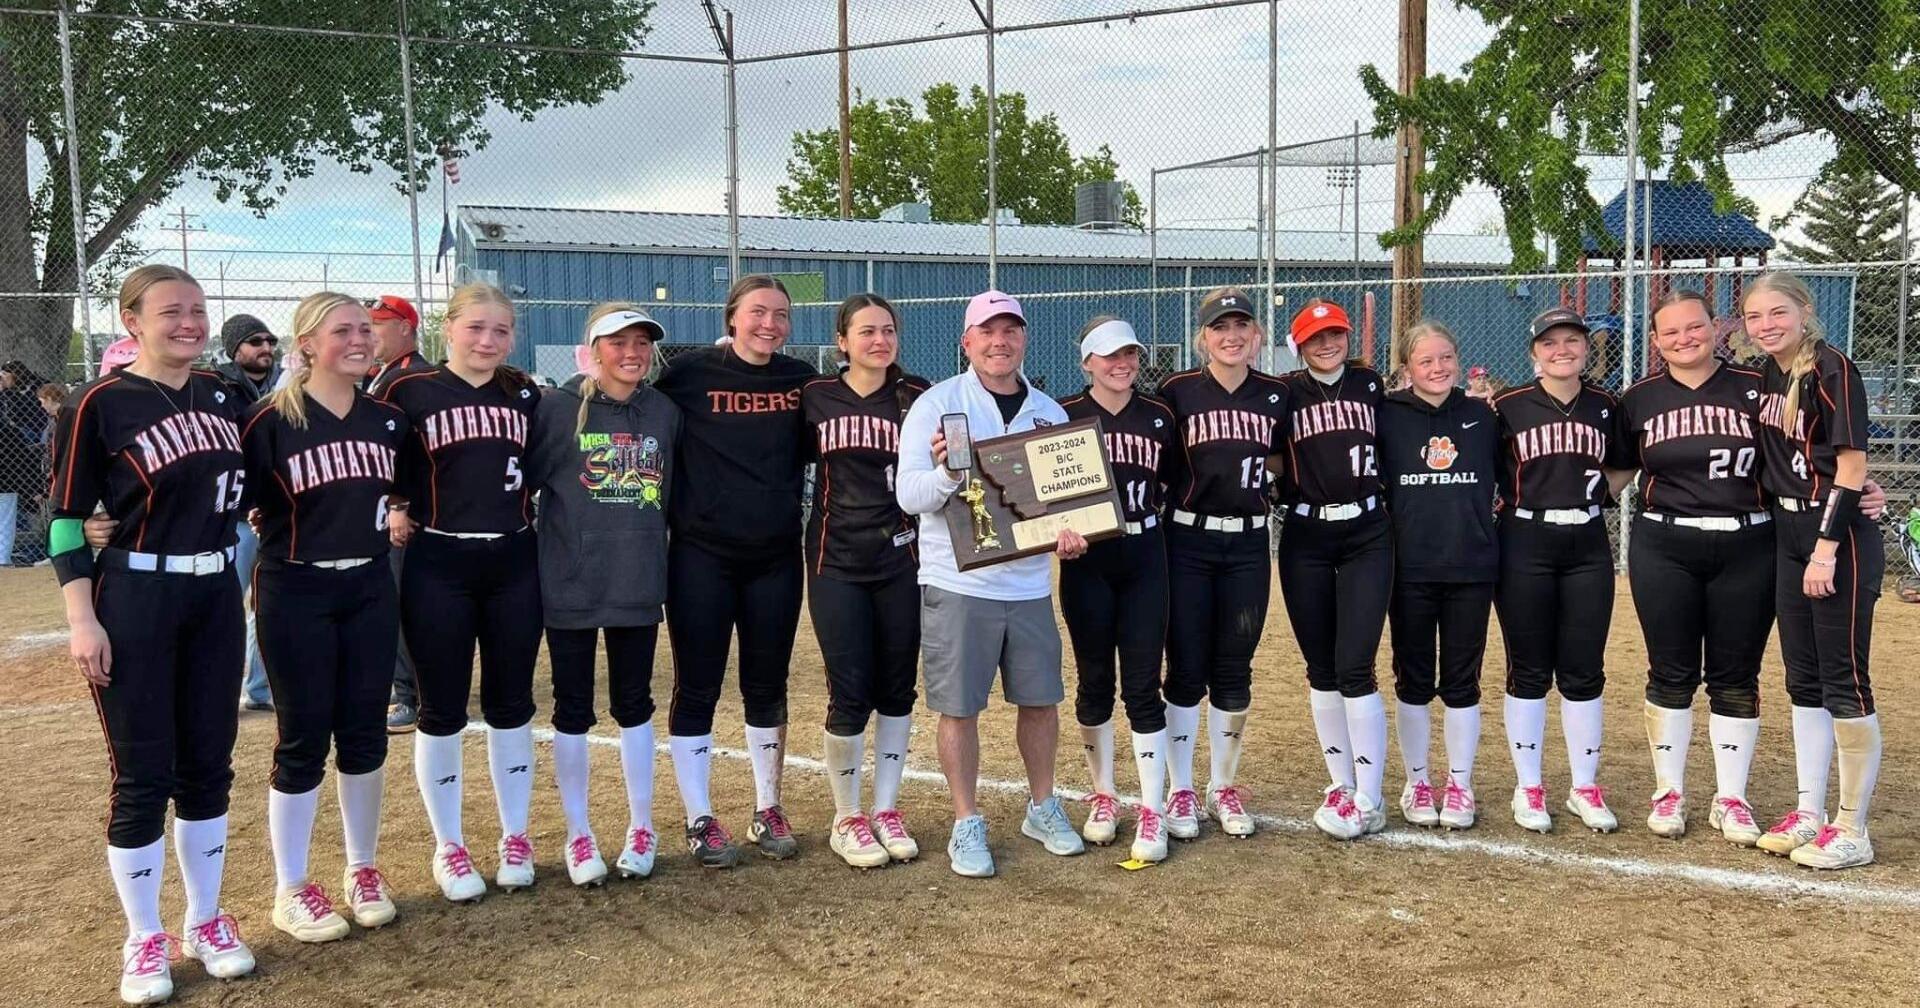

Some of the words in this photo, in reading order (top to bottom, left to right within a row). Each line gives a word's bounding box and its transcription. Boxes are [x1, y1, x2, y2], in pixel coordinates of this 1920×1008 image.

[706, 387, 801, 414] TIGERS
[817, 415, 900, 454] MANHATTA
[1293, 399, 1376, 443] MANHATTA
[580, 433, 610, 452] MHSA
[1038, 436, 1086, 455] 2023-2024
[1056, 452, 1074, 464] B/C
[504, 456, 523, 492] 5
[1052, 463, 1084, 478] STATE
[1241, 456, 1265, 489] 13
[1349, 444, 1378, 477] 12
[1708, 446, 1756, 480] 20
[1791, 449, 1808, 480] 4
[215, 469, 246, 513] 15
[1040, 473, 1102, 495] CHAMPIONS
[1400, 471, 1479, 485] SOFTBALL
[1584, 469, 1602, 500] 7
[1126, 480, 1147, 512] 11
